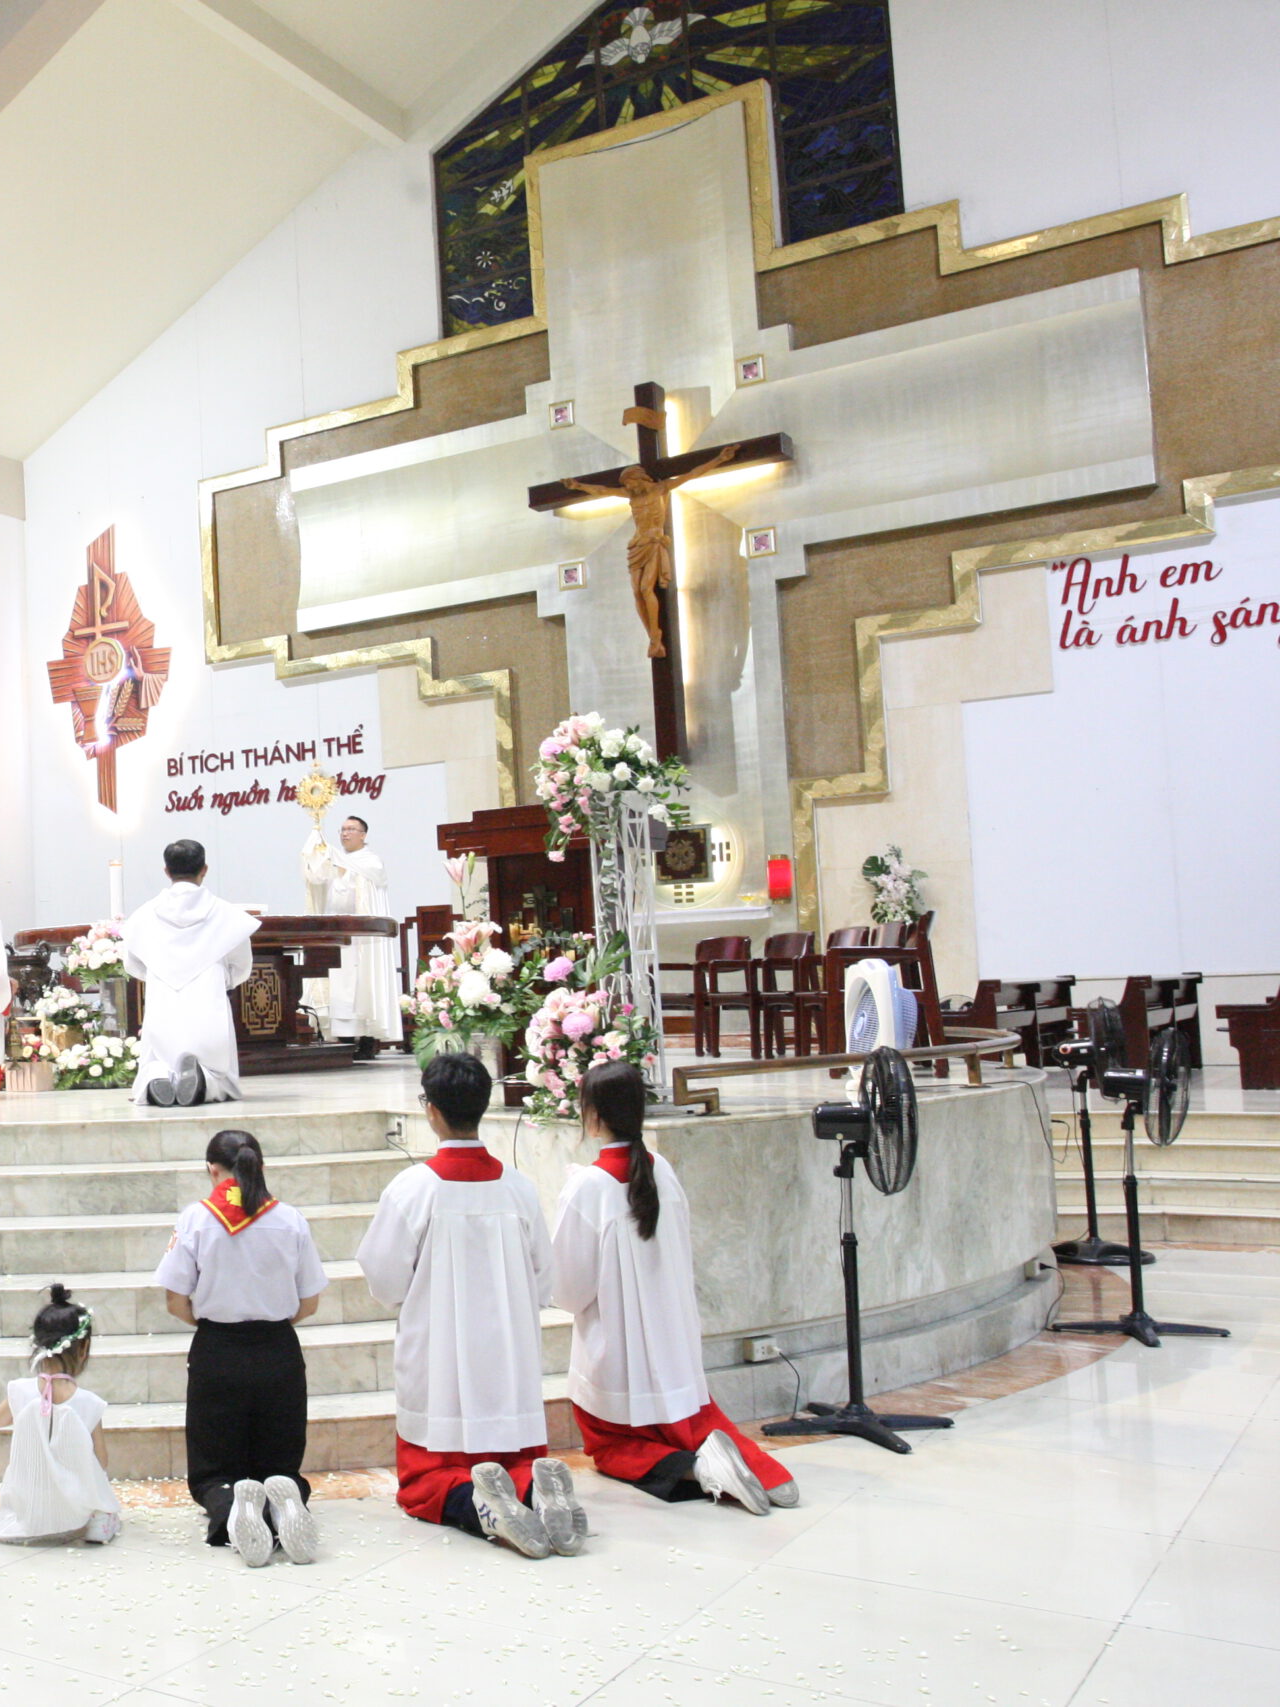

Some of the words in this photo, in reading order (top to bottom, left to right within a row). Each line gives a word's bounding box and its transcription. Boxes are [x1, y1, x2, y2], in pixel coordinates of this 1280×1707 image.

[1159, 560, 1223, 588] em
[1059, 609, 1102, 650] là
[1116, 597, 1198, 646] ánh
[1210, 597, 1280, 648] sán
[167, 752, 183, 777] BÍ
[188, 750, 234, 775] TÍCH
[241, 740, 316, 768] THÁNH
[323, 723, 364, 757] THỂ
[165, 785, 205, 813] Suối
[210, 778, 270, 816] nguồn
[332, 772, 386, 801] hông
